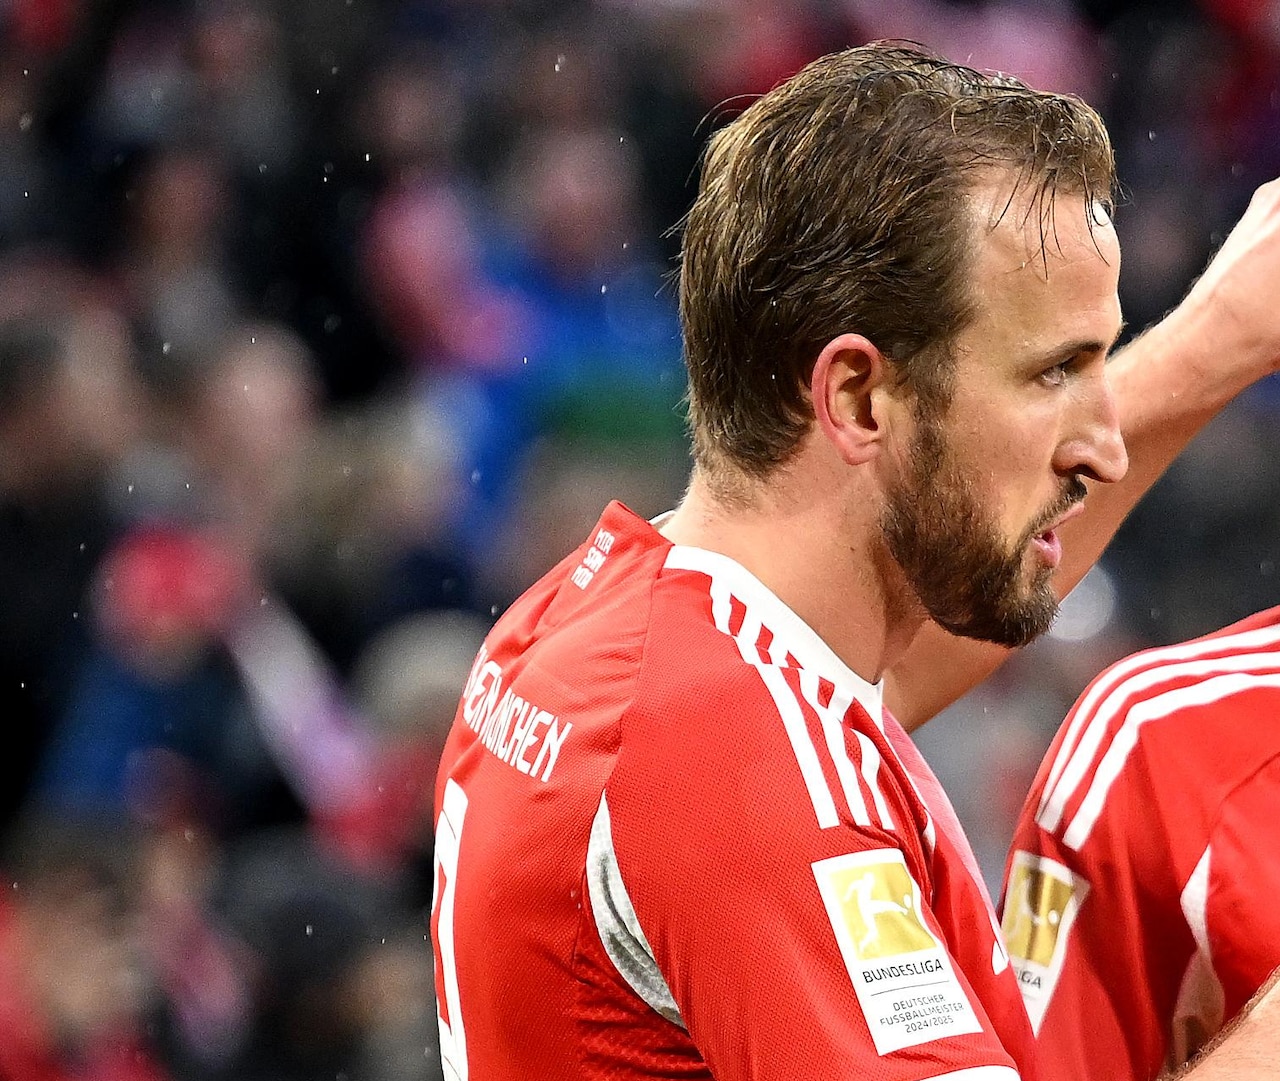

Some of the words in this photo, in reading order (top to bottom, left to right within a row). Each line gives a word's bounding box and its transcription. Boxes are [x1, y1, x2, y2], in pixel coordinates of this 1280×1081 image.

[862, 958, 944, 984] BUNDESLIGA
[892, 994, 946, 1012] DEUTSCHER
[879, 1002, 965, 1026] FUSSBALLMEISTER
[905, 1015, 955, 1033] 2024/2025
